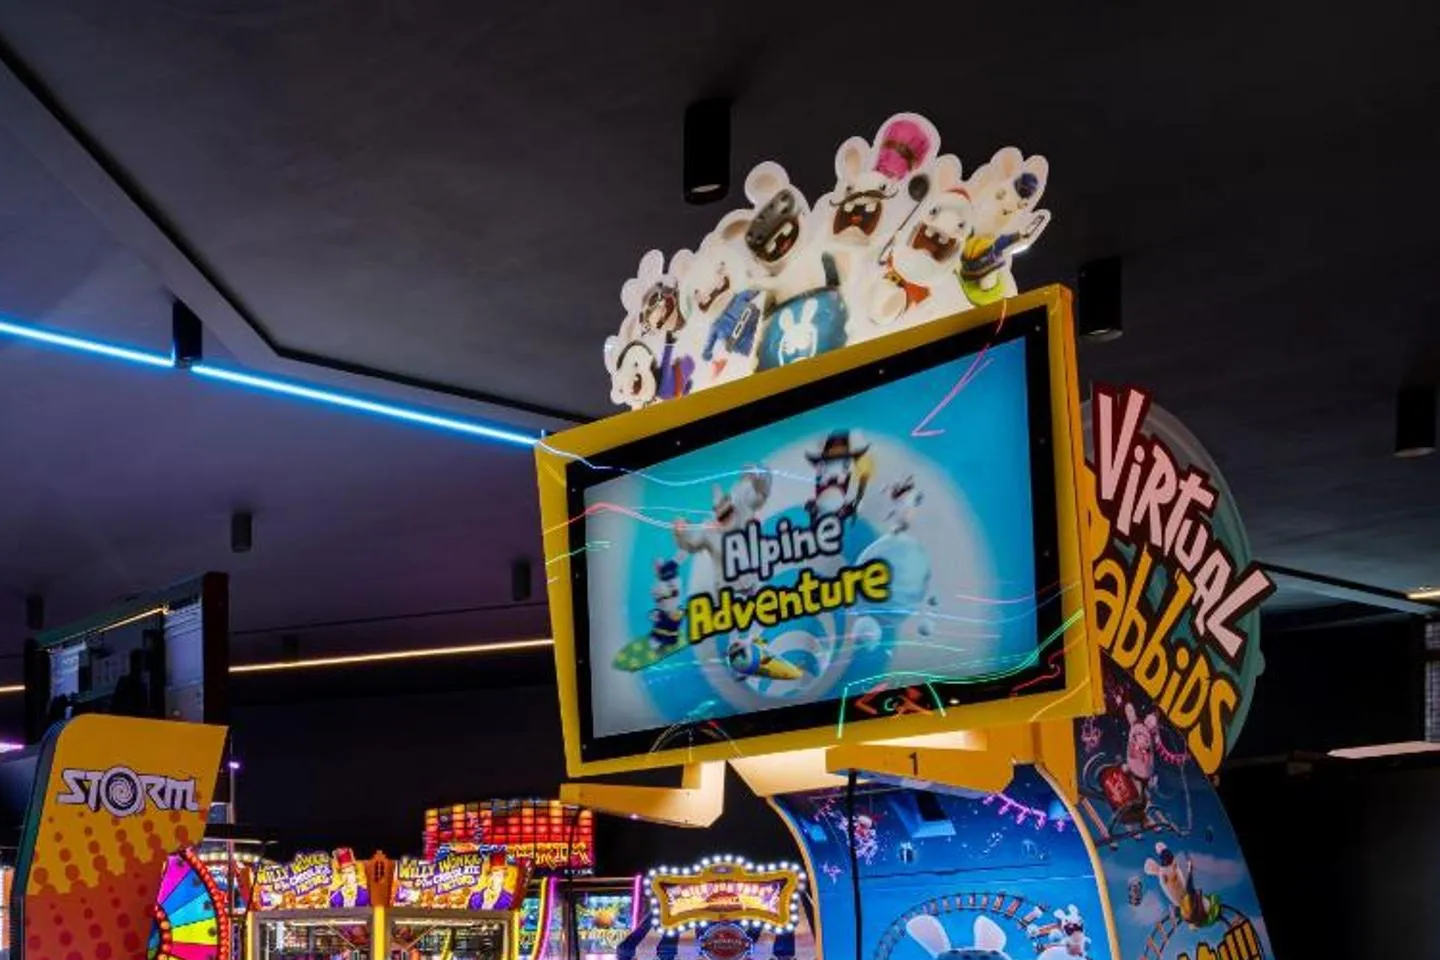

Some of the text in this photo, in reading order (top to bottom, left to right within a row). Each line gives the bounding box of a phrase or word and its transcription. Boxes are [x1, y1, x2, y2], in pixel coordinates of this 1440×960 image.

[723, 517, 843, 580] Alpine
[688, 562, 891, 643] Adventure
[57, 766, 202, 817] STORM
[909, 753, 918, 776] 1
